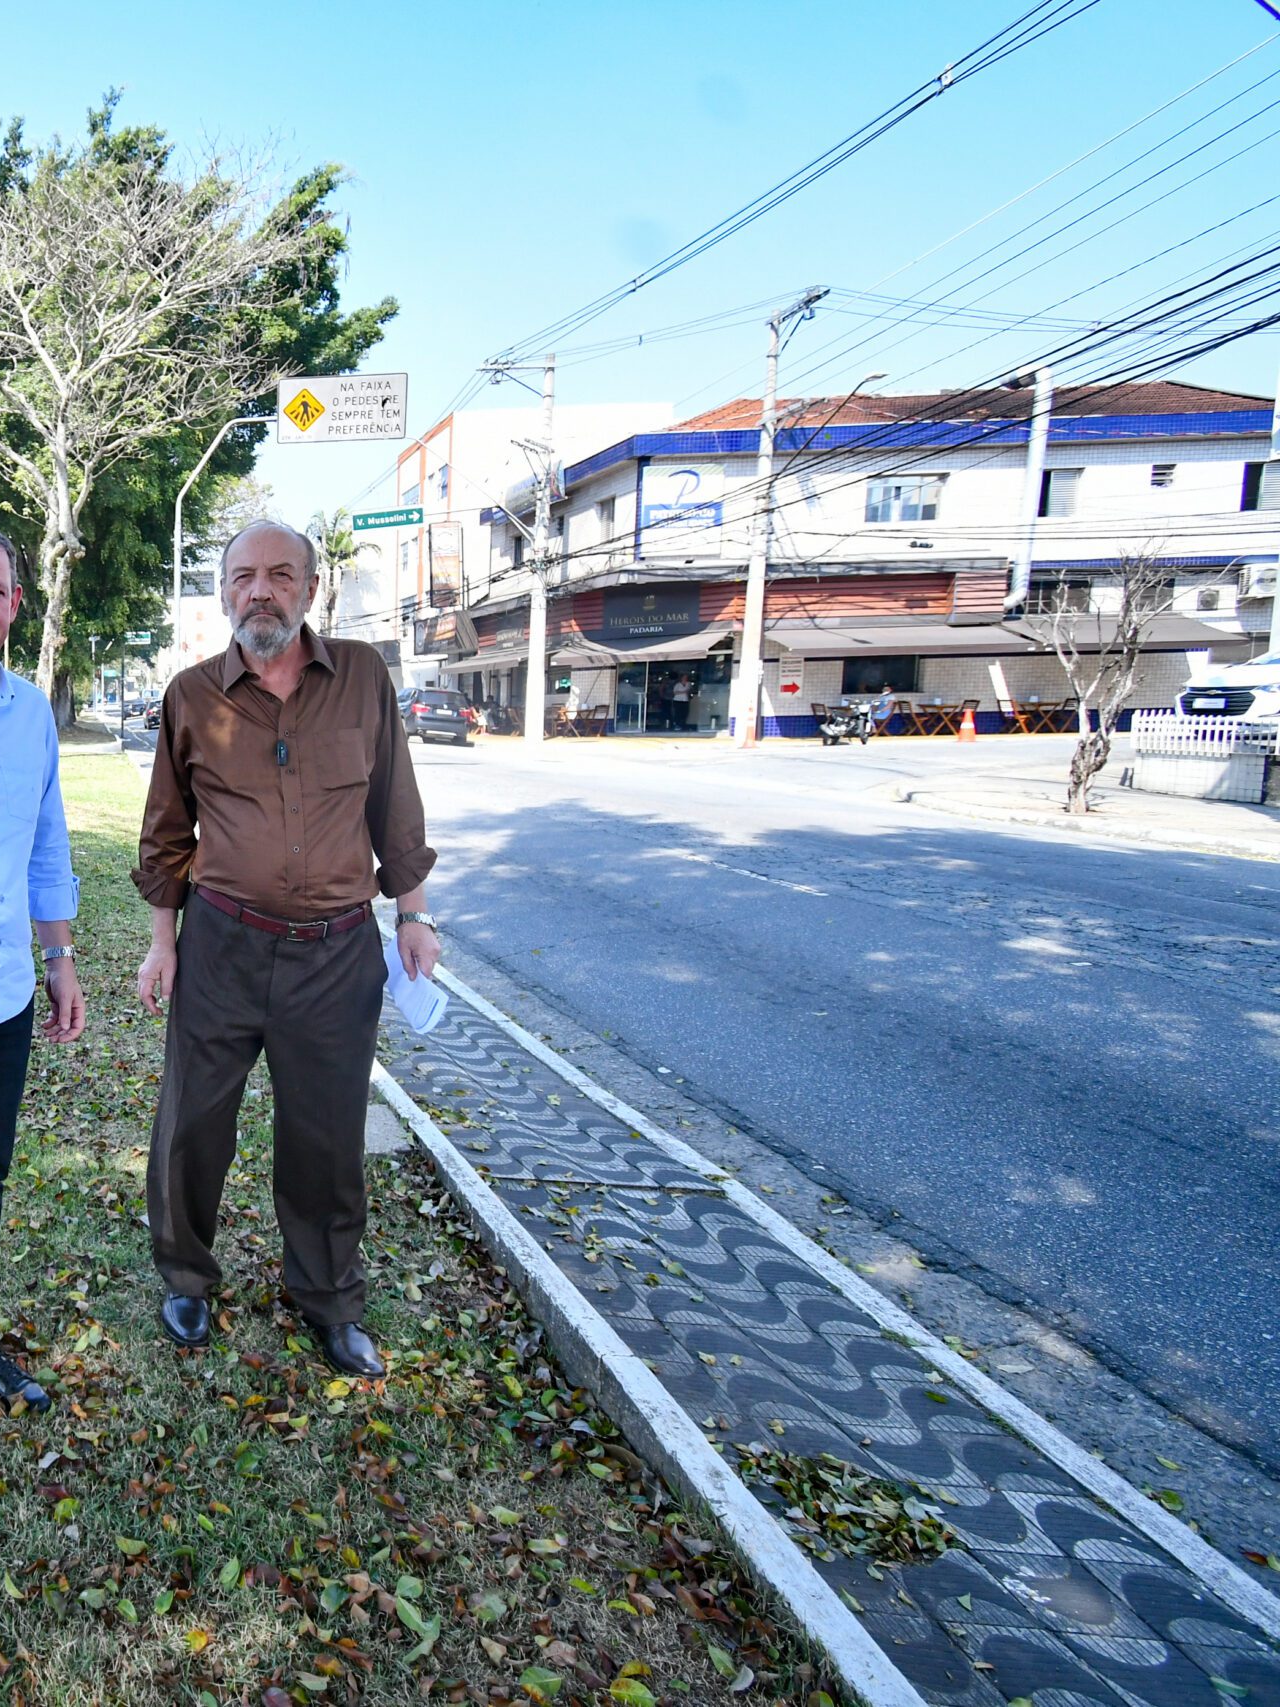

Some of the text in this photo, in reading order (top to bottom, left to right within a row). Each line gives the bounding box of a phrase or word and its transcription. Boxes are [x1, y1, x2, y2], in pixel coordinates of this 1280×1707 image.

[340, 381, 392, 392] NA FAIXA
[332, 395, 399, 407] O PEDESTRE
[331, 409, 401, 421] SEMPRE TEM
[328, 422, 401, 435] PREFERÊNCIA
[356, 513, 407, 527] V. Mussolini
[665, 612, 689, 622] MAR
[629, 626, 664, 634] PADARIA
